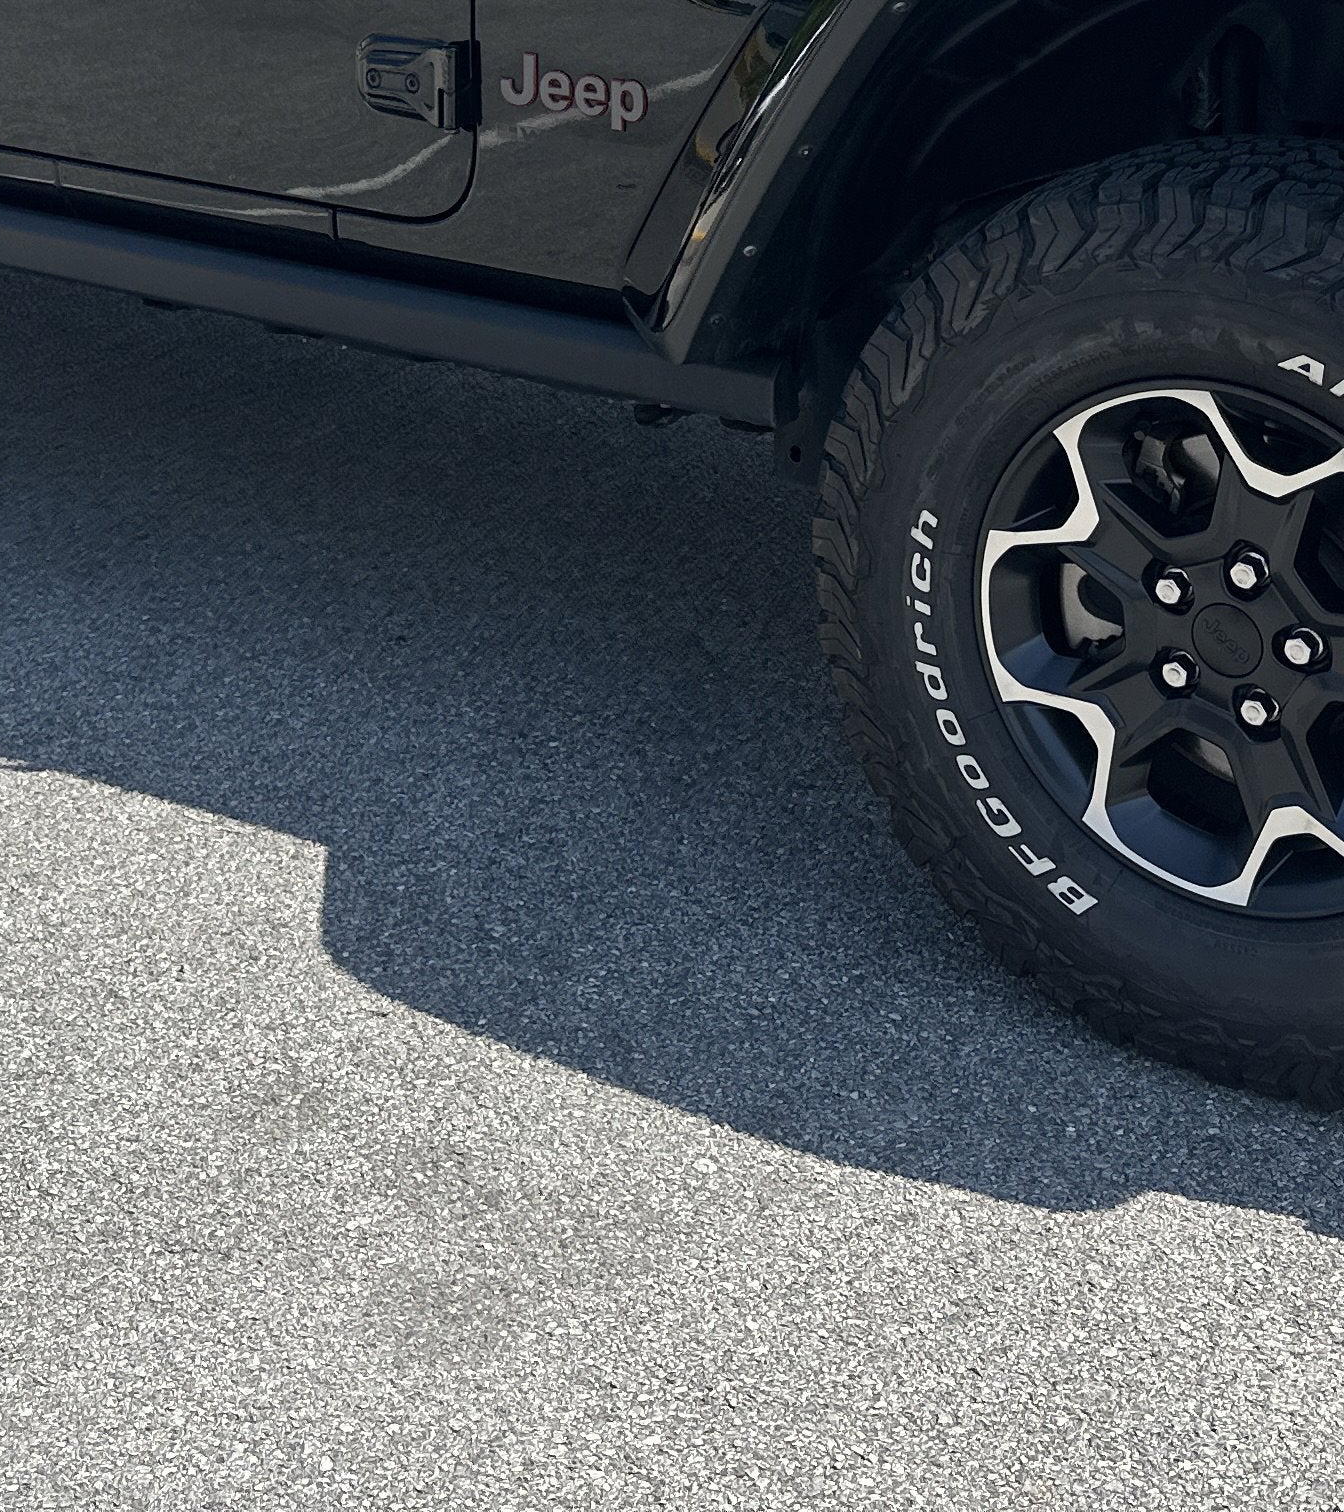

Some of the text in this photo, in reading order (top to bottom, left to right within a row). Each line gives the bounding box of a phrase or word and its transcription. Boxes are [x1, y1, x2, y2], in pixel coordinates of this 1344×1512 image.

[500, 51, 649, 132] Jeep
[1202, 619, 1250, 665] Jeep
[905, 508, 1100, 917] BFGoodrich
